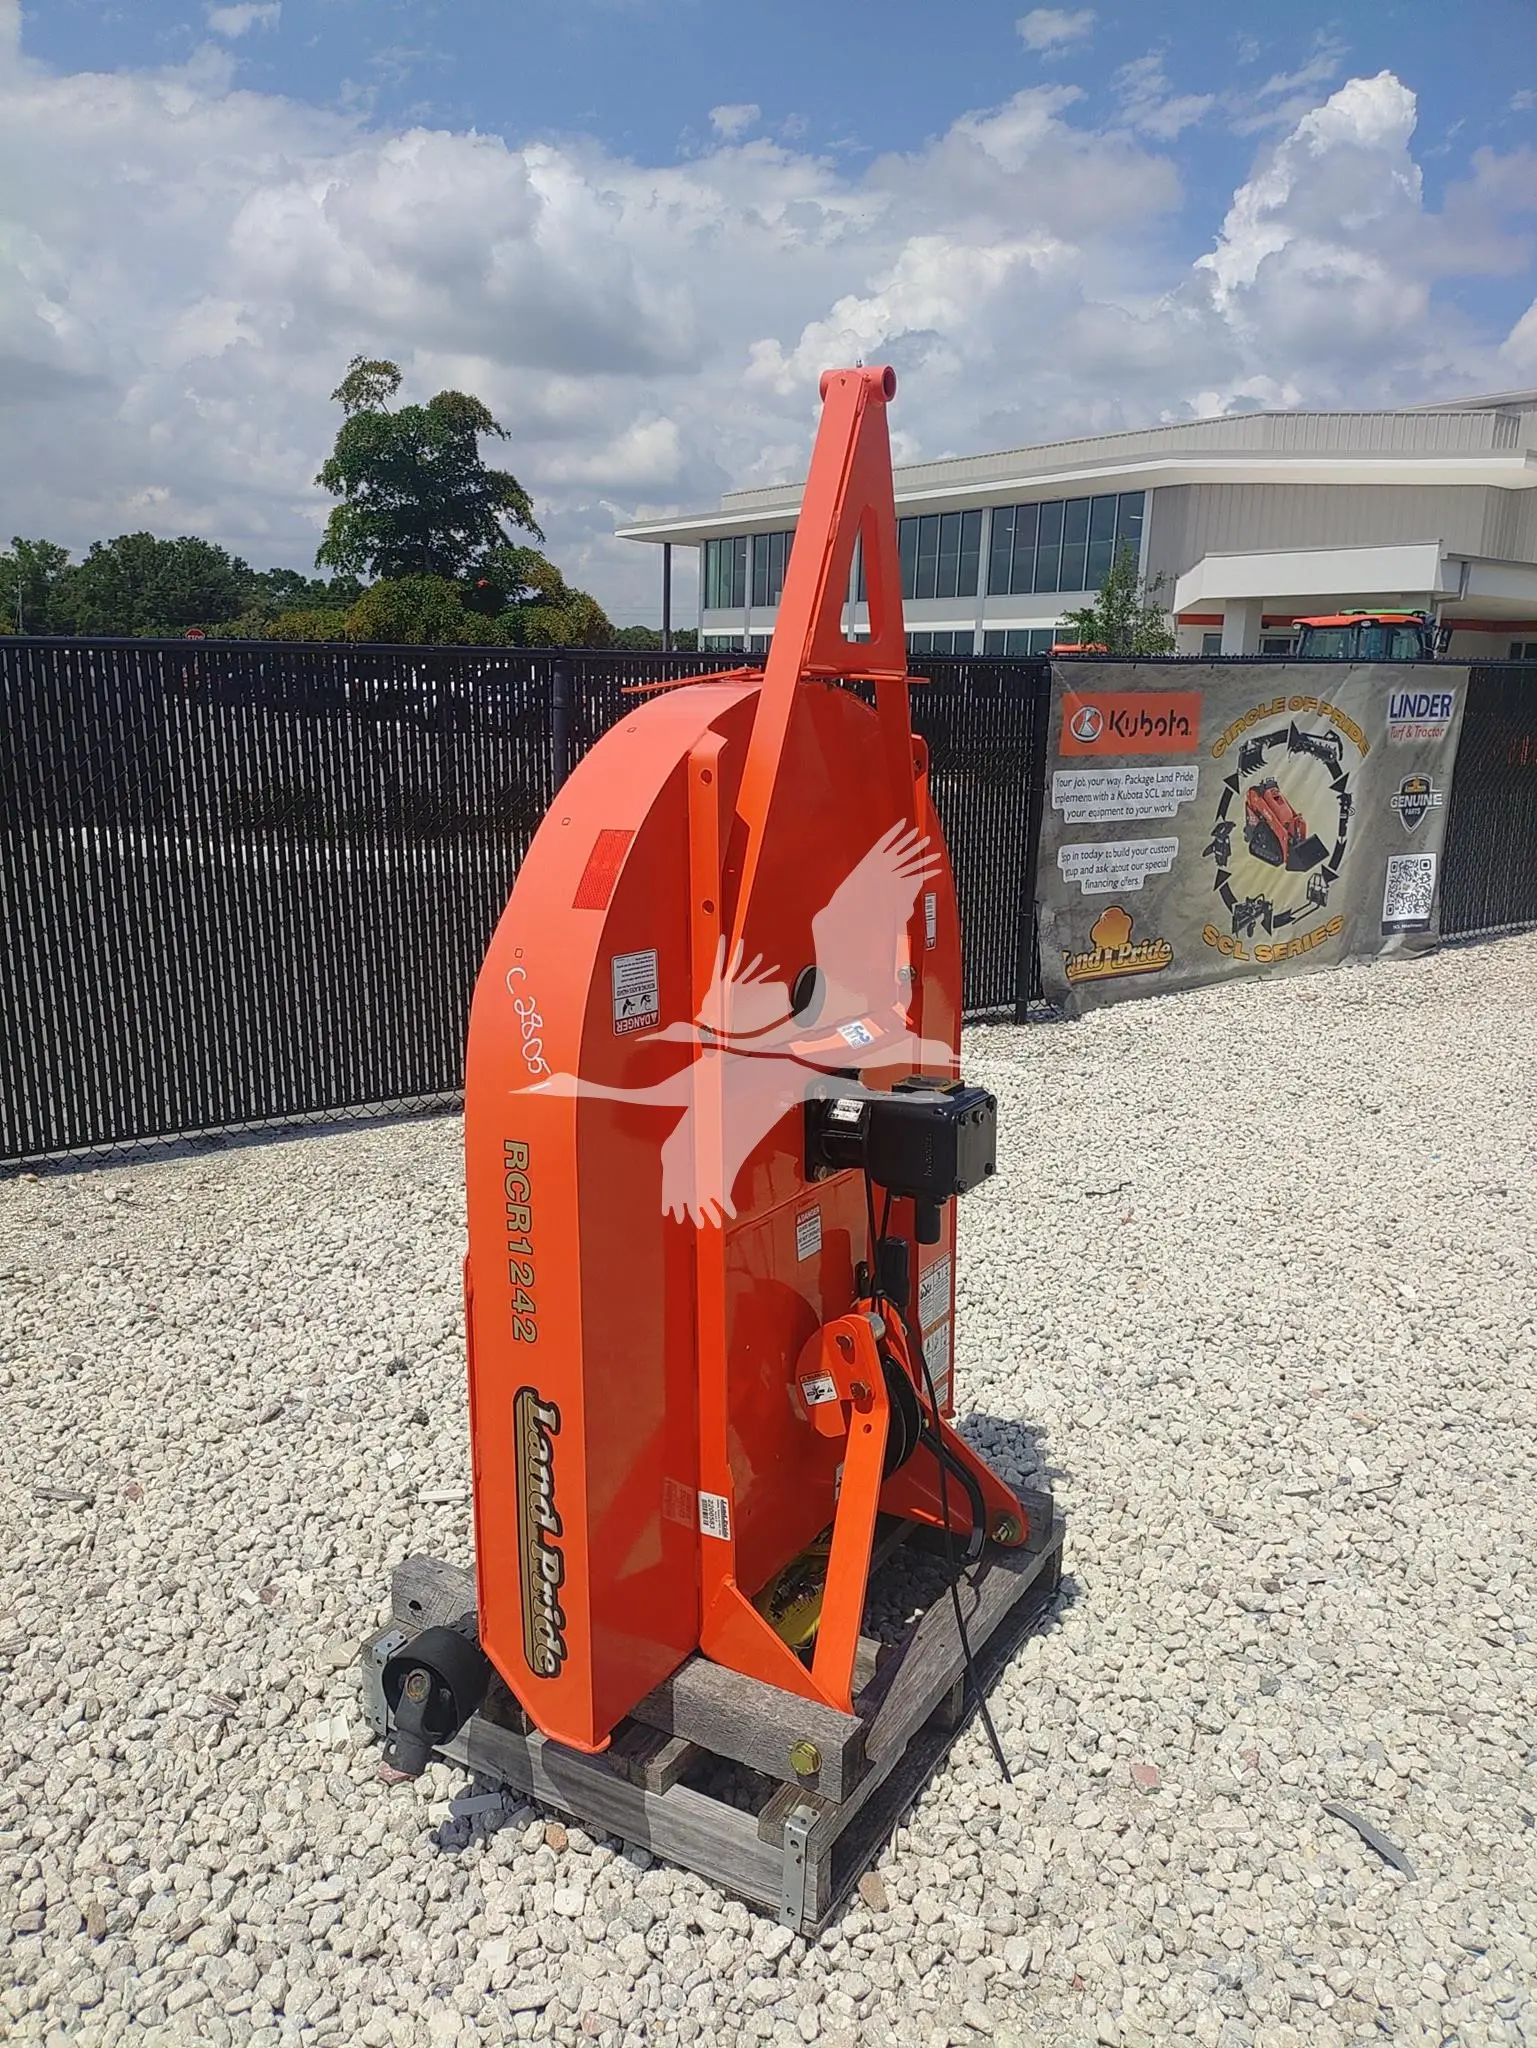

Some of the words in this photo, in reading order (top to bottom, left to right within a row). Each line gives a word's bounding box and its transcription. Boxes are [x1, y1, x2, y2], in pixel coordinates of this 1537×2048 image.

[1390, 694, 1452, 719] LINDER
[1108, 709, 1190, 738] Kubota
[1211, 696, 1286, 759] CIRCLE
[1288, 695, 1318, 712] OF
[1317, 700, 1371, 758] PRIDE
[1390, 725, 1405, 741] Turf
[1405, 726, 1412, 738] &
[1414, 725, 1445, 739] Tractor
[1056, 777, 1072, 788] Your
[1087, 778, 1105, 789] your
[1125, 774, 1154, 787] Package
[1156, 772, 1173, 783] Land
[1175, 771, 1194, 782] Pride
[1092, 791, 1108, 801] with
[1117, 790, 1143, 801] Kubota
[1144, 788, 1160, 799] SCL
[1161, 787, 1174, 798] and
[1175, 787, 1195, 797] tailor
[1390, 793, 1443, 808] GENUINE
[1067, 809, 1086, 821] your
[1125, 807, 1134, 815] to
[1135, 806, 1152, 817] your
[1072, 851, 1079, 860] in
[1081, 849, 1104, 861] today
[1113, 846, 1130, 858] build
[1131, 847, 1149, 859] your
[1149, 845, 1176, 855] custom
[1080, 864, 1094, 875] and
[1095, 863, 1109, 874] ask
[1130, 863, 1144, 871] our
[1145, 857, 1169, 871] special
[1085, 877, 1119, 890] financing
[1202, 924, 1250, 962] SCL
[1254, 915, 1345, 963] SERIES
[1117, 938, 1173, 967] Pride
[616, 1013, 652, 1032] DANGER
[504, 1140, 537, 1344] RCR1242
[525, 1397, 563, 1537] Land
[530, 1541, 567, 1678] Pride
